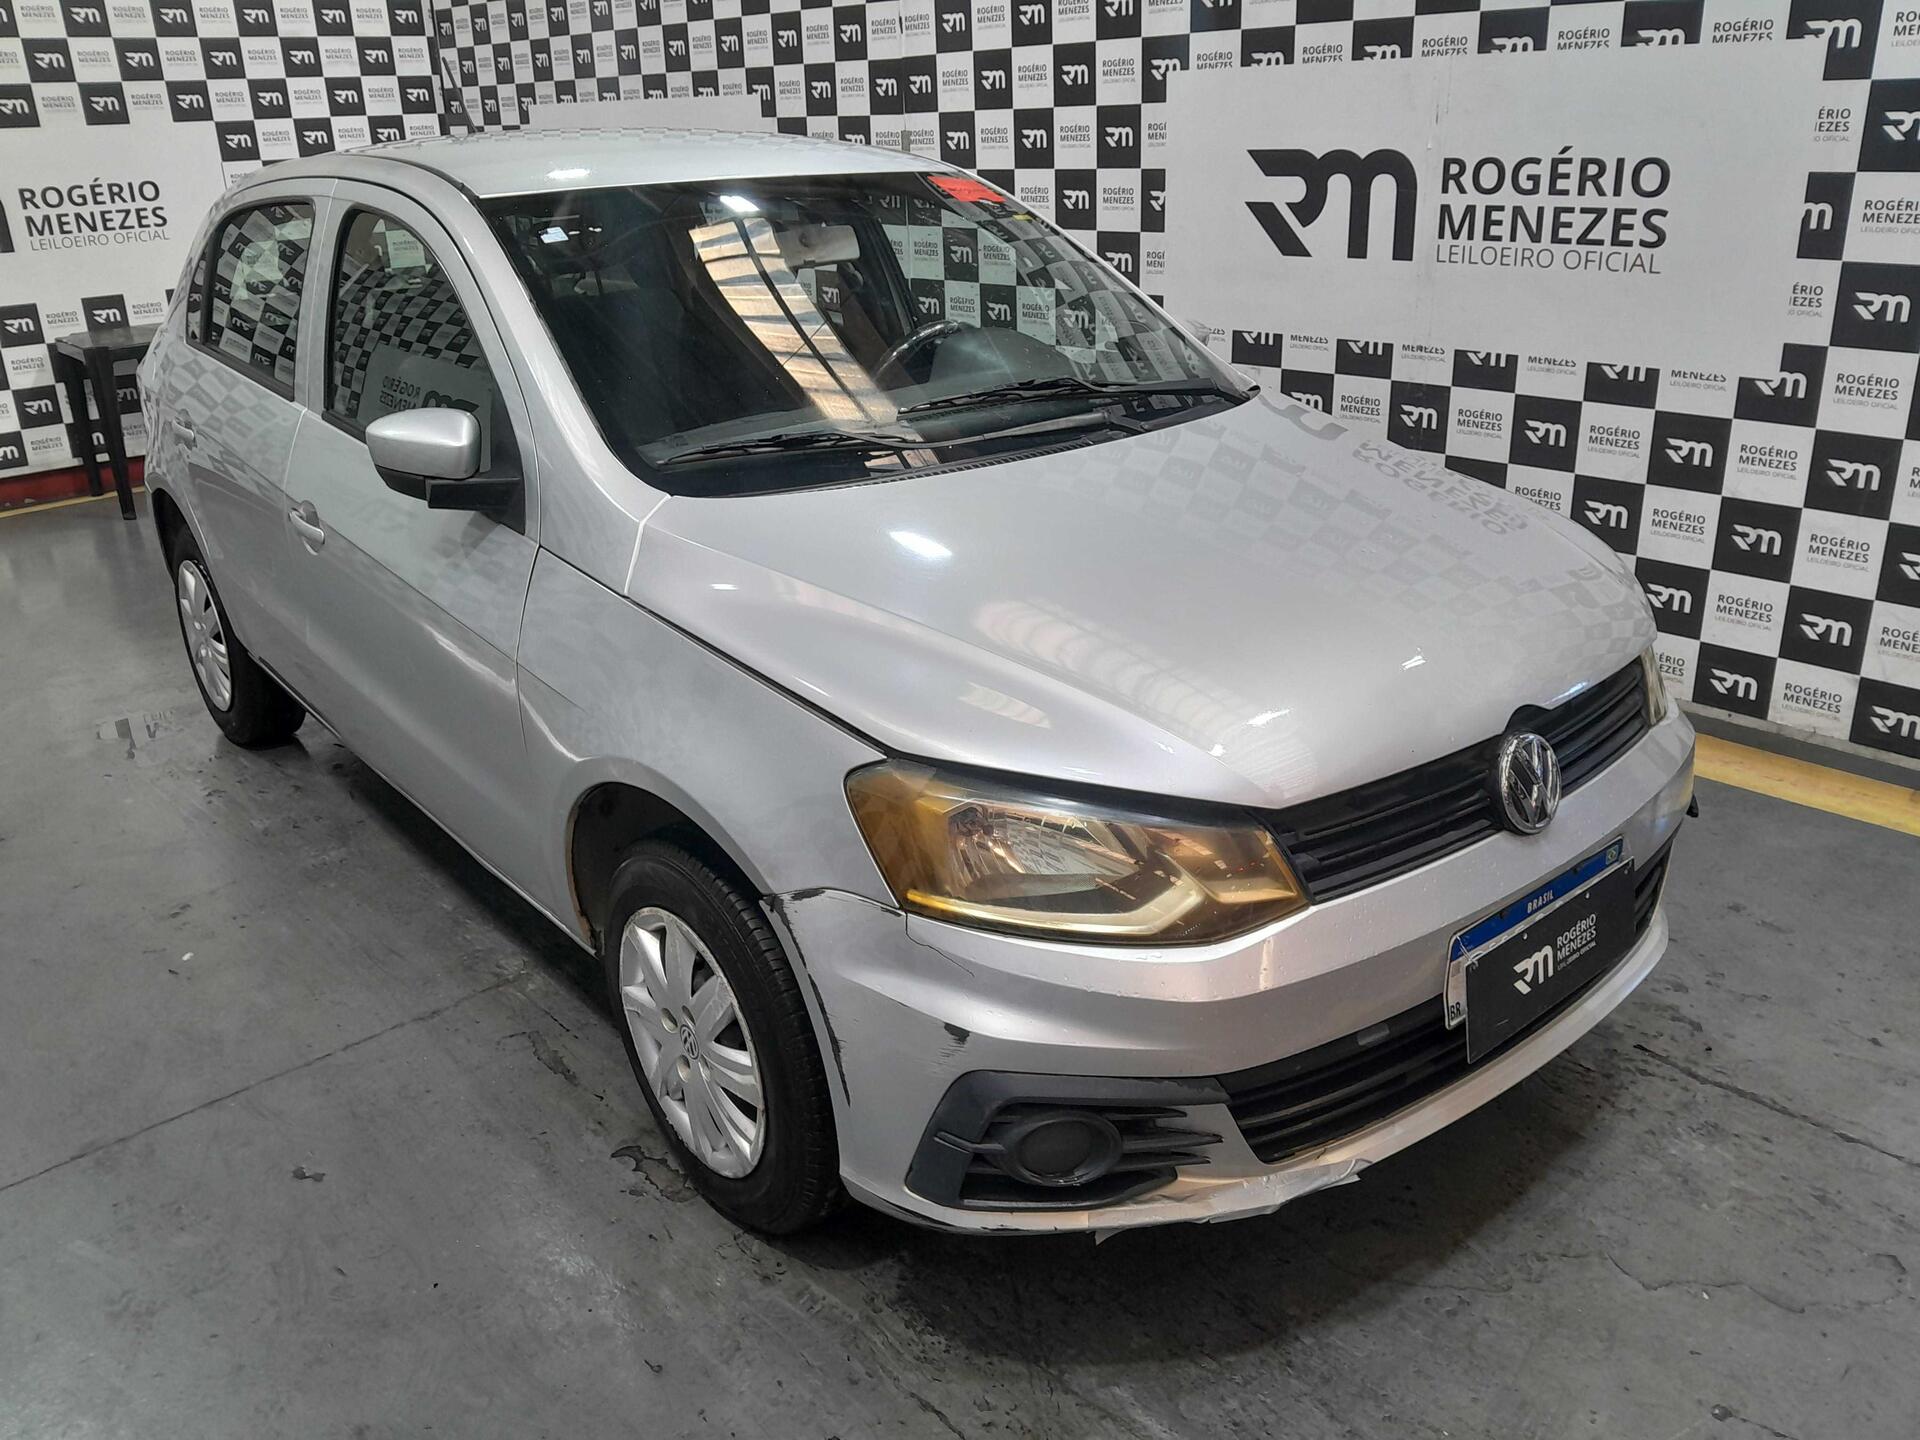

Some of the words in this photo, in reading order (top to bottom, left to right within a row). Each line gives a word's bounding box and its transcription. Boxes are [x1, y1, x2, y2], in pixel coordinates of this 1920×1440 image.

[977, 5, 1004, 14] ROGÉRIO
[1058, 5, 1089, 15] MENEZES
[872, 18, 896, 26] ROGÉRIO
[905, 14, 929, 23] ROGÉRIO
[978, 14, 1005, 23] MENEZES
[1714, 18, 1773, 32] ROGÉRIO
[806, 24, 828, 32] ROGÉRIO
[872, 26, 896, 34] MENEZES
[905, 22, 929, 31] MENEZES
[807, 32, 829, 40] MENEZES
[1558, 27, 1610, 40] ROGÉRIO
[1422, 35, 1468, 48] ROGÉRIO
[1303, 43, 1342, 55] ROGÉRIO
[1103, 58, 1134, 67] ROGÉRIO
[1197, 51, 1232, 61] ROGÉRIO
[942, 70, 968, 78] ROGÉRIO
[1018, 64, 1046, 73] ROGÉRIO
[1103, 67, 1135, 76] MENEZES
[943, 78, 968, 86] MENEZES
[1018, 73, 1047, 81] MENEZES
[876, 131, 900, 139] ROGÉRIO
[981, 127, 1008, 135] ROGÉRIO
[1060, 124, 1090, 133] ROGÉRIO
[1060, 134, 1090, 142] MENEZES
[1441, 145, 1671, 198] ROGÉRIO
[18, 177, 160, 210] ROGÉRIO
[1021, 186, 1048, 194] ROGÉRIO
[1103, 187, 1134, 195] ROGÉRIO
[1103, 196, 1134, 204] MENEZES
[24, 206, 168, 237] MENEZES
[1437, 204, 1669, 248] MENEZES
[30, 233, 110, 251] LEILOEIRO
[113, 229, 171, 244] OFICIAL
[1436, 244, 1554, 269] LEILOEIRO
[1562, 249, 1661, 274] OFICIAL
[1837, 373, 1899, 388] ROGÉRIO
[1835, 385, 1898, 400] MENEZES
[1341, 395, 1380, 406] ROGÉRIO
[1341, 404, 1380, 416] MENEZES
[1458, 409, 1502, 421] ROGÉRIO
[1457, 418, 1502, 431] MENEZES
[1590, 425, 1640, 439] ROGÉRIO
[1589, 435, 1639, 450] MENEZES
[1741, 444, 1798, 460] ROGÉRIO
[1739, 455, 1796, 471] MENEZES
[1514, 486, 1562, 501] ROGÉRIO
[1653, 508, 1705, 524] ROGÉRIO
[1652, 518, 1704, 535] MENEZES
[1810, 534, 1870, 552] ROGÉRIO
[1808, 545, 1868, 563] MENEZES
[1718, 594, 1773, 612] ROGÉRIO
[1716, 604, 1771, 622] MENEZES
[1785, 683, 1842, 703] ROGÉRIO
[1784, 693, 1840, 713] MENEZES
[1527, 890, 1554, 913] BRASIL
[1556, 913, 1597, 948] ROGÉRIO
[1556, 925, 1597, 961] MENEZES
[1450, 1002, 1461, 1020] BR
